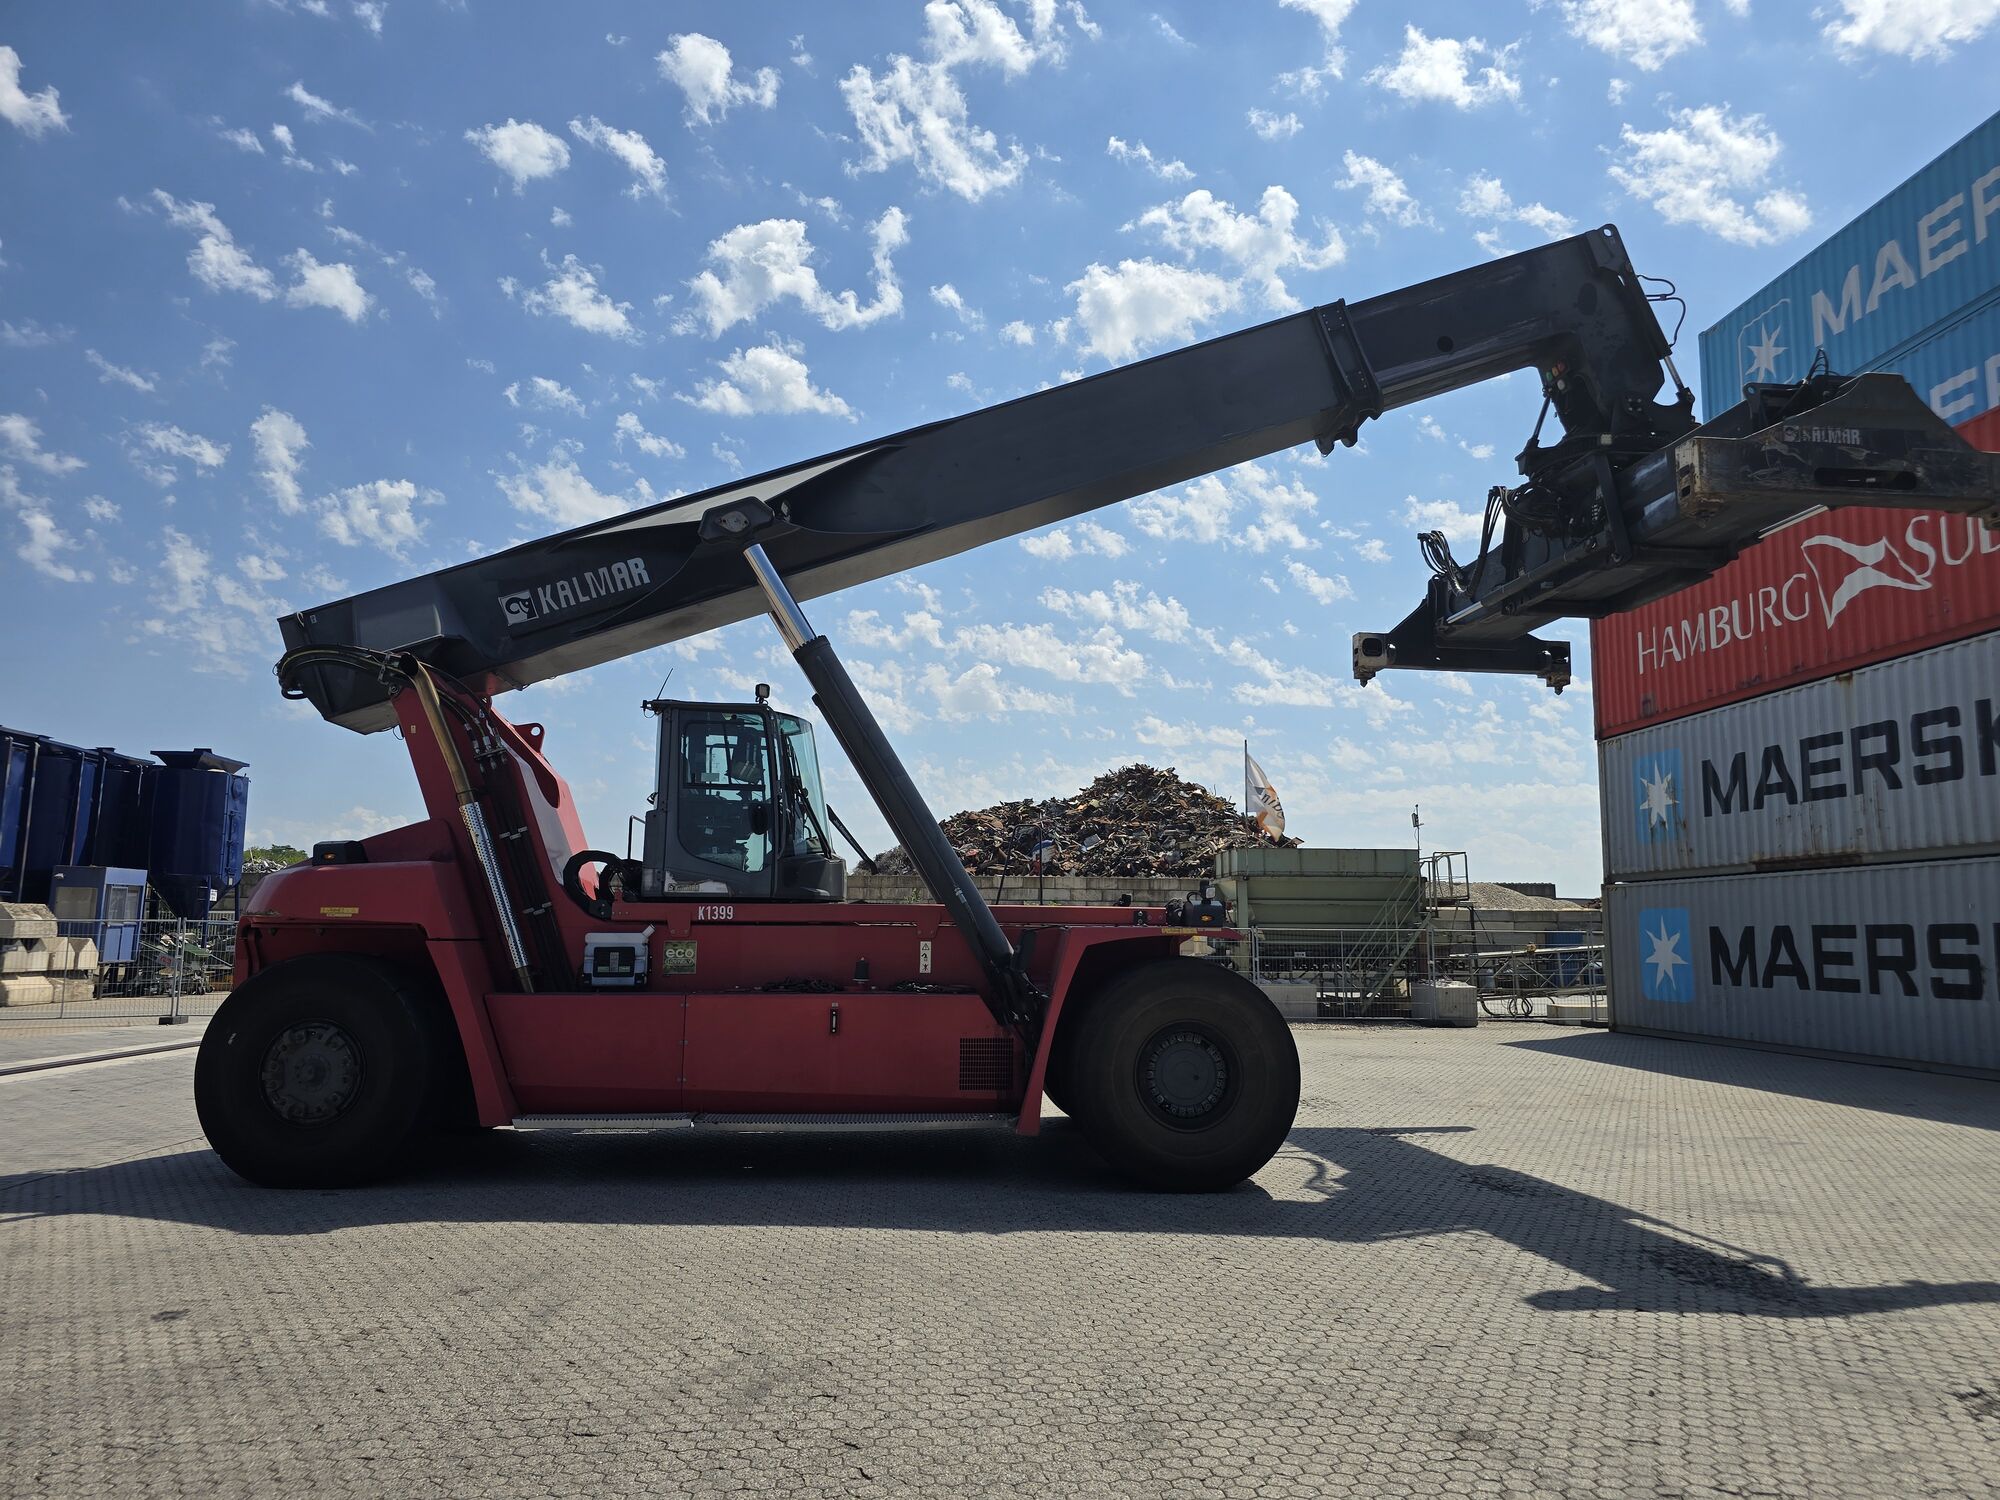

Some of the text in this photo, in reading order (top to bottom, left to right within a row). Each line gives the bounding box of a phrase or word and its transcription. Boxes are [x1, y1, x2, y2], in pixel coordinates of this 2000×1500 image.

[537, 557, 650, 615] KALMAR
[1637, 573, 1809, 675] HAMBURG
[698, 906, 734, 920] K1399
[666, 948, 694, 958] eco
[1709, 923, 2000, 1000] MAERS
